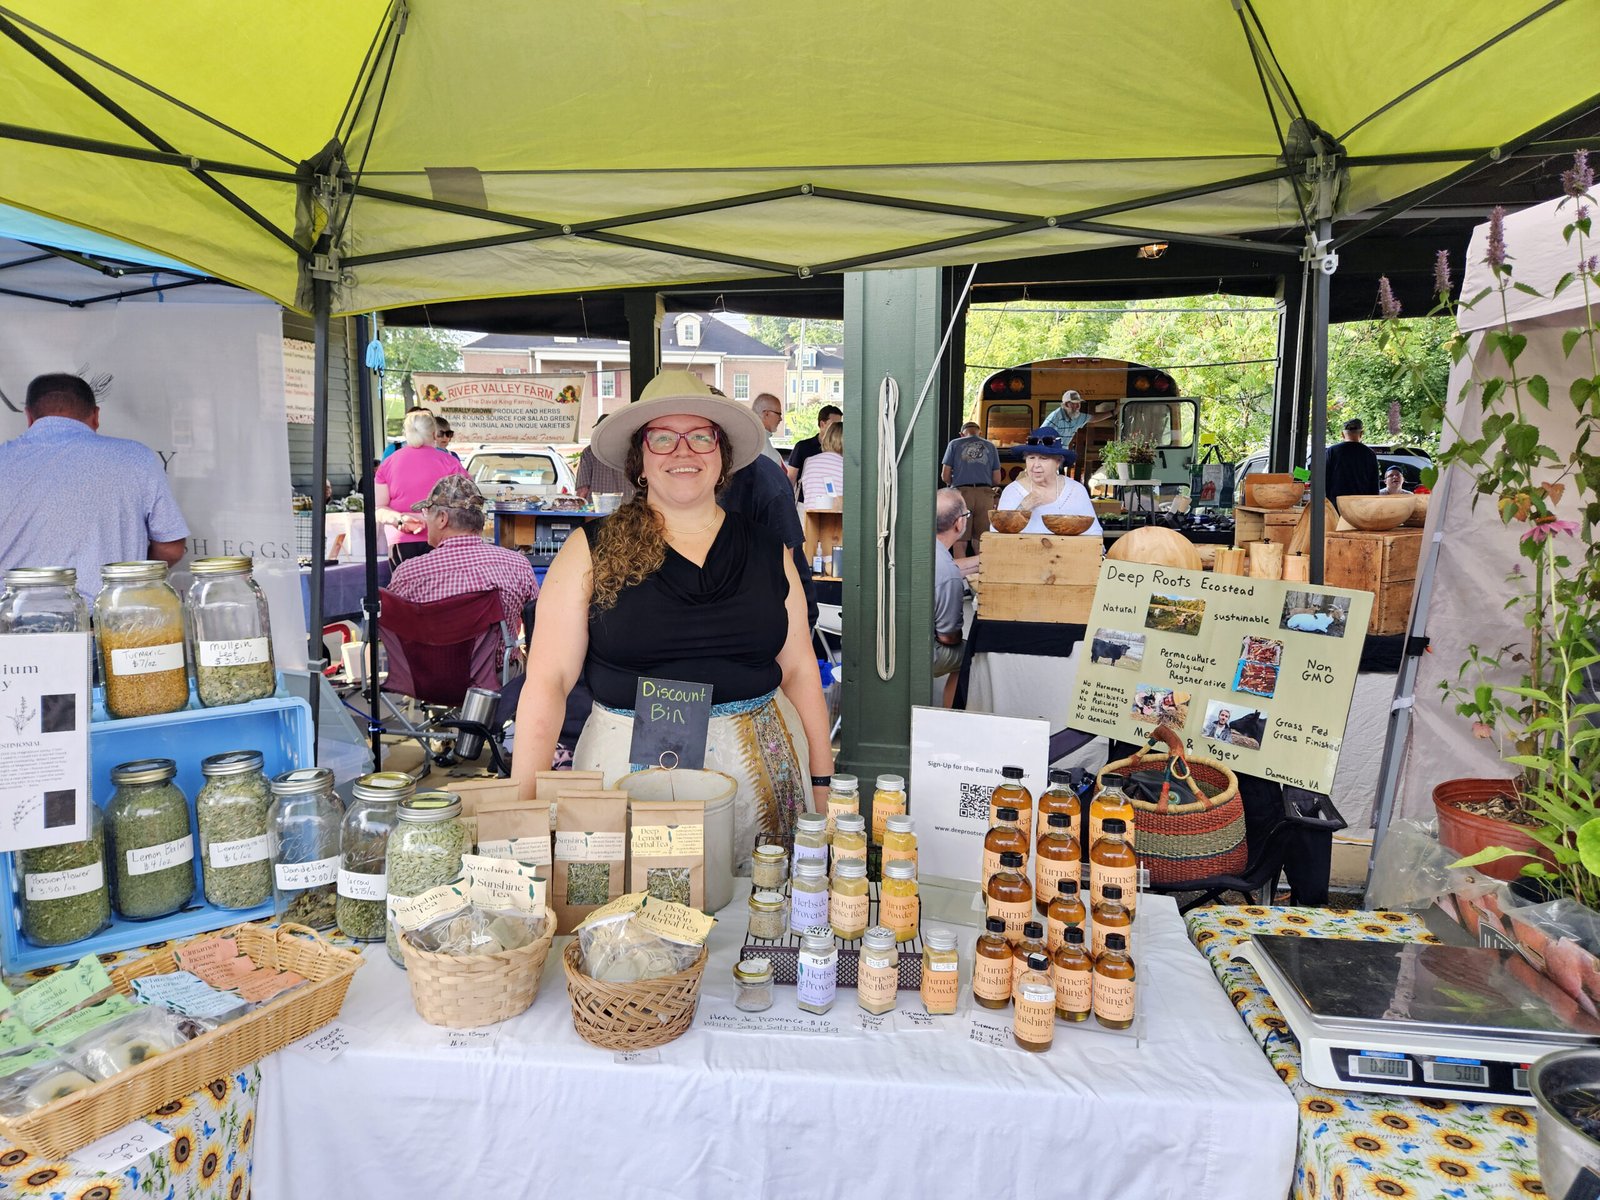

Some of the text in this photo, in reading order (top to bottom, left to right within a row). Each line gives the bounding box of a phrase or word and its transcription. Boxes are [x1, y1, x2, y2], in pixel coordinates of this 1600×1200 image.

[449, 383, 553, 400] RIVER VALLEY FARM
[223, 540, 290, 560] EGGS
[1107, 565, 1254, 597] Deep Roots Ecostead
[1102, 603, 1270, 624] Natural sustainable
[123, 649, 177, 660] Turmeric
[1160, 648, 1216, 666] Permaculture
[1166, 659, 1205, 673] Biological
[1307, 659, 1332, 673] Non
[1169, 670, 1227, 690] Regenerative
[1302, 671, 1334, 684] GMO
[643, 681, 706, 703] Discount
[1083, 679, 1125, 695] No Hormones
[1092, 697, 1118, 709] Pesticides
[1094, 691, 1128, 704] Antibiotics
[650, 703, 685, 725] Bin
[1077, 703, 1119, 718] No Herbicides
[1075, 712, 1116, 726] No Chemicals
[1275, 718, 1328, 737] Grass Fed
[1273, 730, 1297, 743] Grass
[1187, 738, 1194, 750] &
[1208, 744, 1239, 761] Yogev
[928, 760, 952, 770] Sign-Up
[953, 763, 962, 771] for
[976, 767, 993, 775] Email
[1265, 767, 1319, 790] Damascus, VA
[640, 828, 660, 836] Deep
[632, 841, 655, 849] Herbal
[132, 850, 162, 864] Lemon
[282, 864, 329, 874] Dandelion
[31, 870, 91, 886] Passionflower
[477, 878, 525, 893] Sunshine
[490, 888, 511, 898] Tea
[399, 890, 449, 914] Sunshine
[418, 901, 438, 915] Tea
[795, 896, 819, 908] Herbs
[657, 909, 692, 924] Lemon
[664, 904, 691, 918] Deep
[887, 909, 913, 920] Powder
[646, 912, 699, 934] Herbal Tea
[182, 942, 220, 958] Cinnamon
[742, 1015, 756, 1024] de
[759, 1016, 804, 1025] Provence
